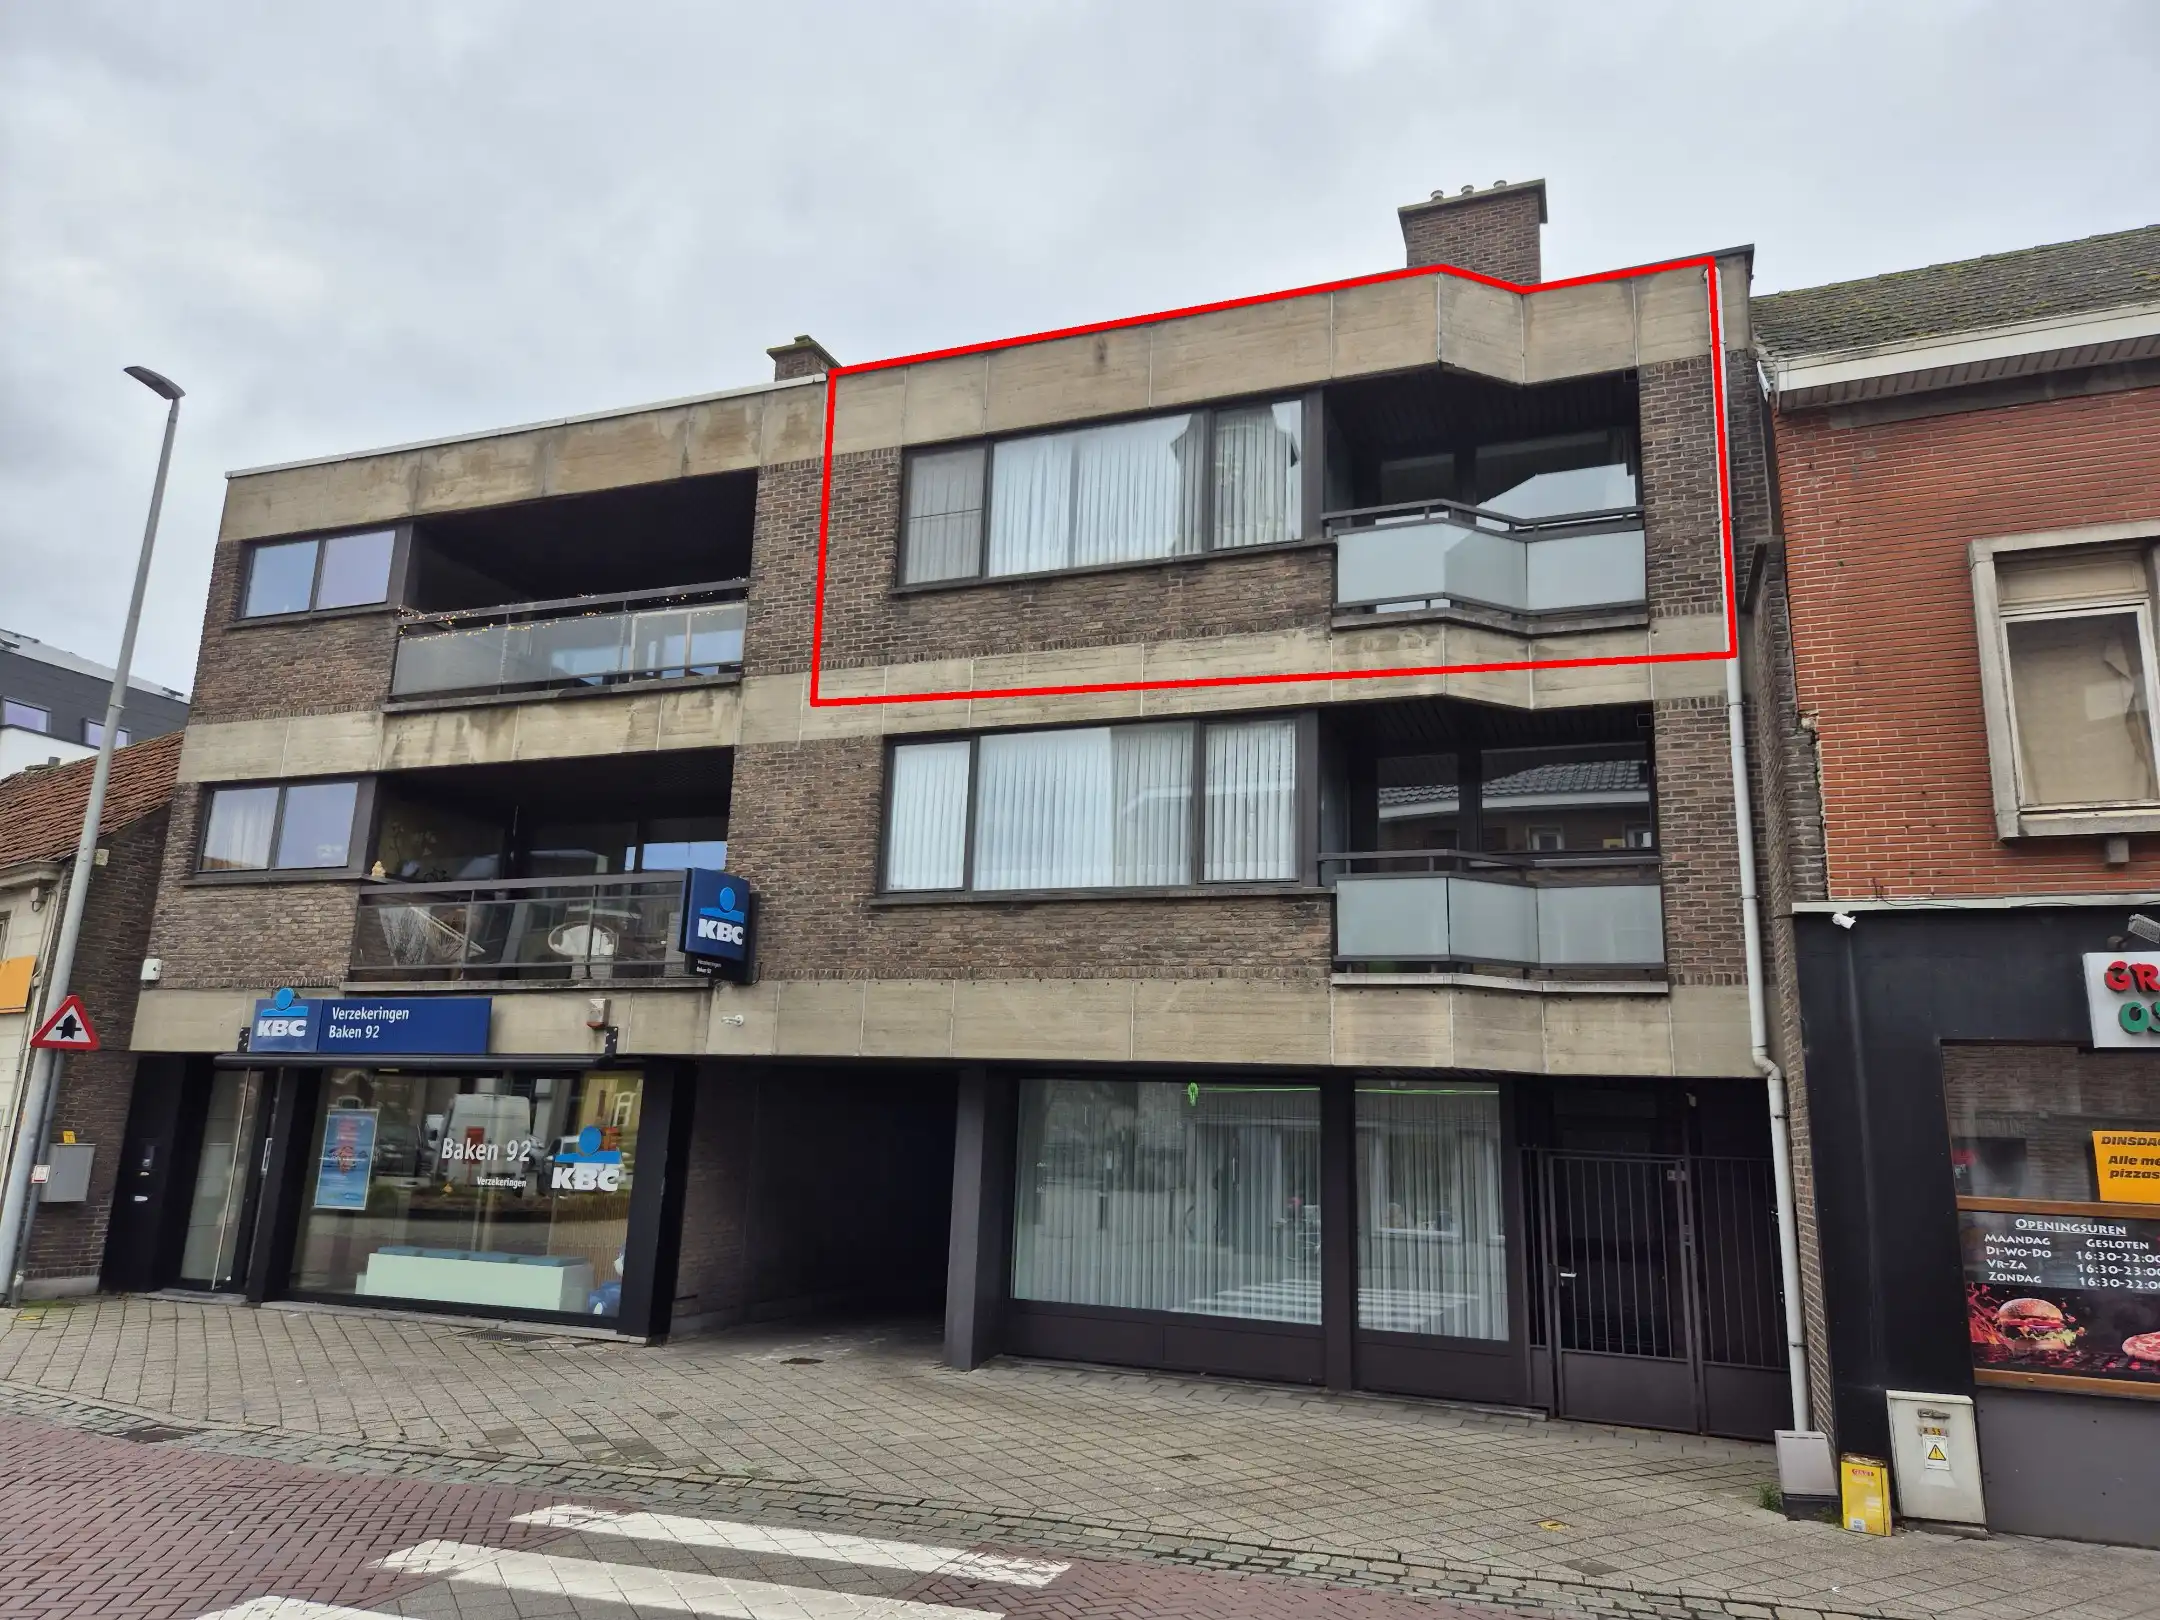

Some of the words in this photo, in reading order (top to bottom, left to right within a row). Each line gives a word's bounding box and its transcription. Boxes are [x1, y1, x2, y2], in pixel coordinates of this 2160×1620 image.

[698, 918, 744, 946] KBC
[332, 1006, 409, 1023] Verzekeringen
[257, 1019, 307, 1037] KBC
[329, 1025, 362, 1038] Baken
[365, 1025, 380, 1039] 92
[2101, 1136, 2160, 1146] DINSDA
[441, 1138, 498, 1161] Baken
[506, 1140, 531, 1162] 92
[2108, 1155, 2138, 1165] Alle
[477, 1176, 527, 1189] Verzekeringen
[551, 1167, 620, 1192] KBC
[2015, 1218, 2127, 1236] OPENINGSUREN
[1984, 1233, 2051, 1246] MAANDAG
[2086, 1238, 2149, 1250] GESLOTEN
[1988, 1271, 2042, 1284] ZONDAG
[2079, 1276, 2160, 1290] 16:30-22:0
